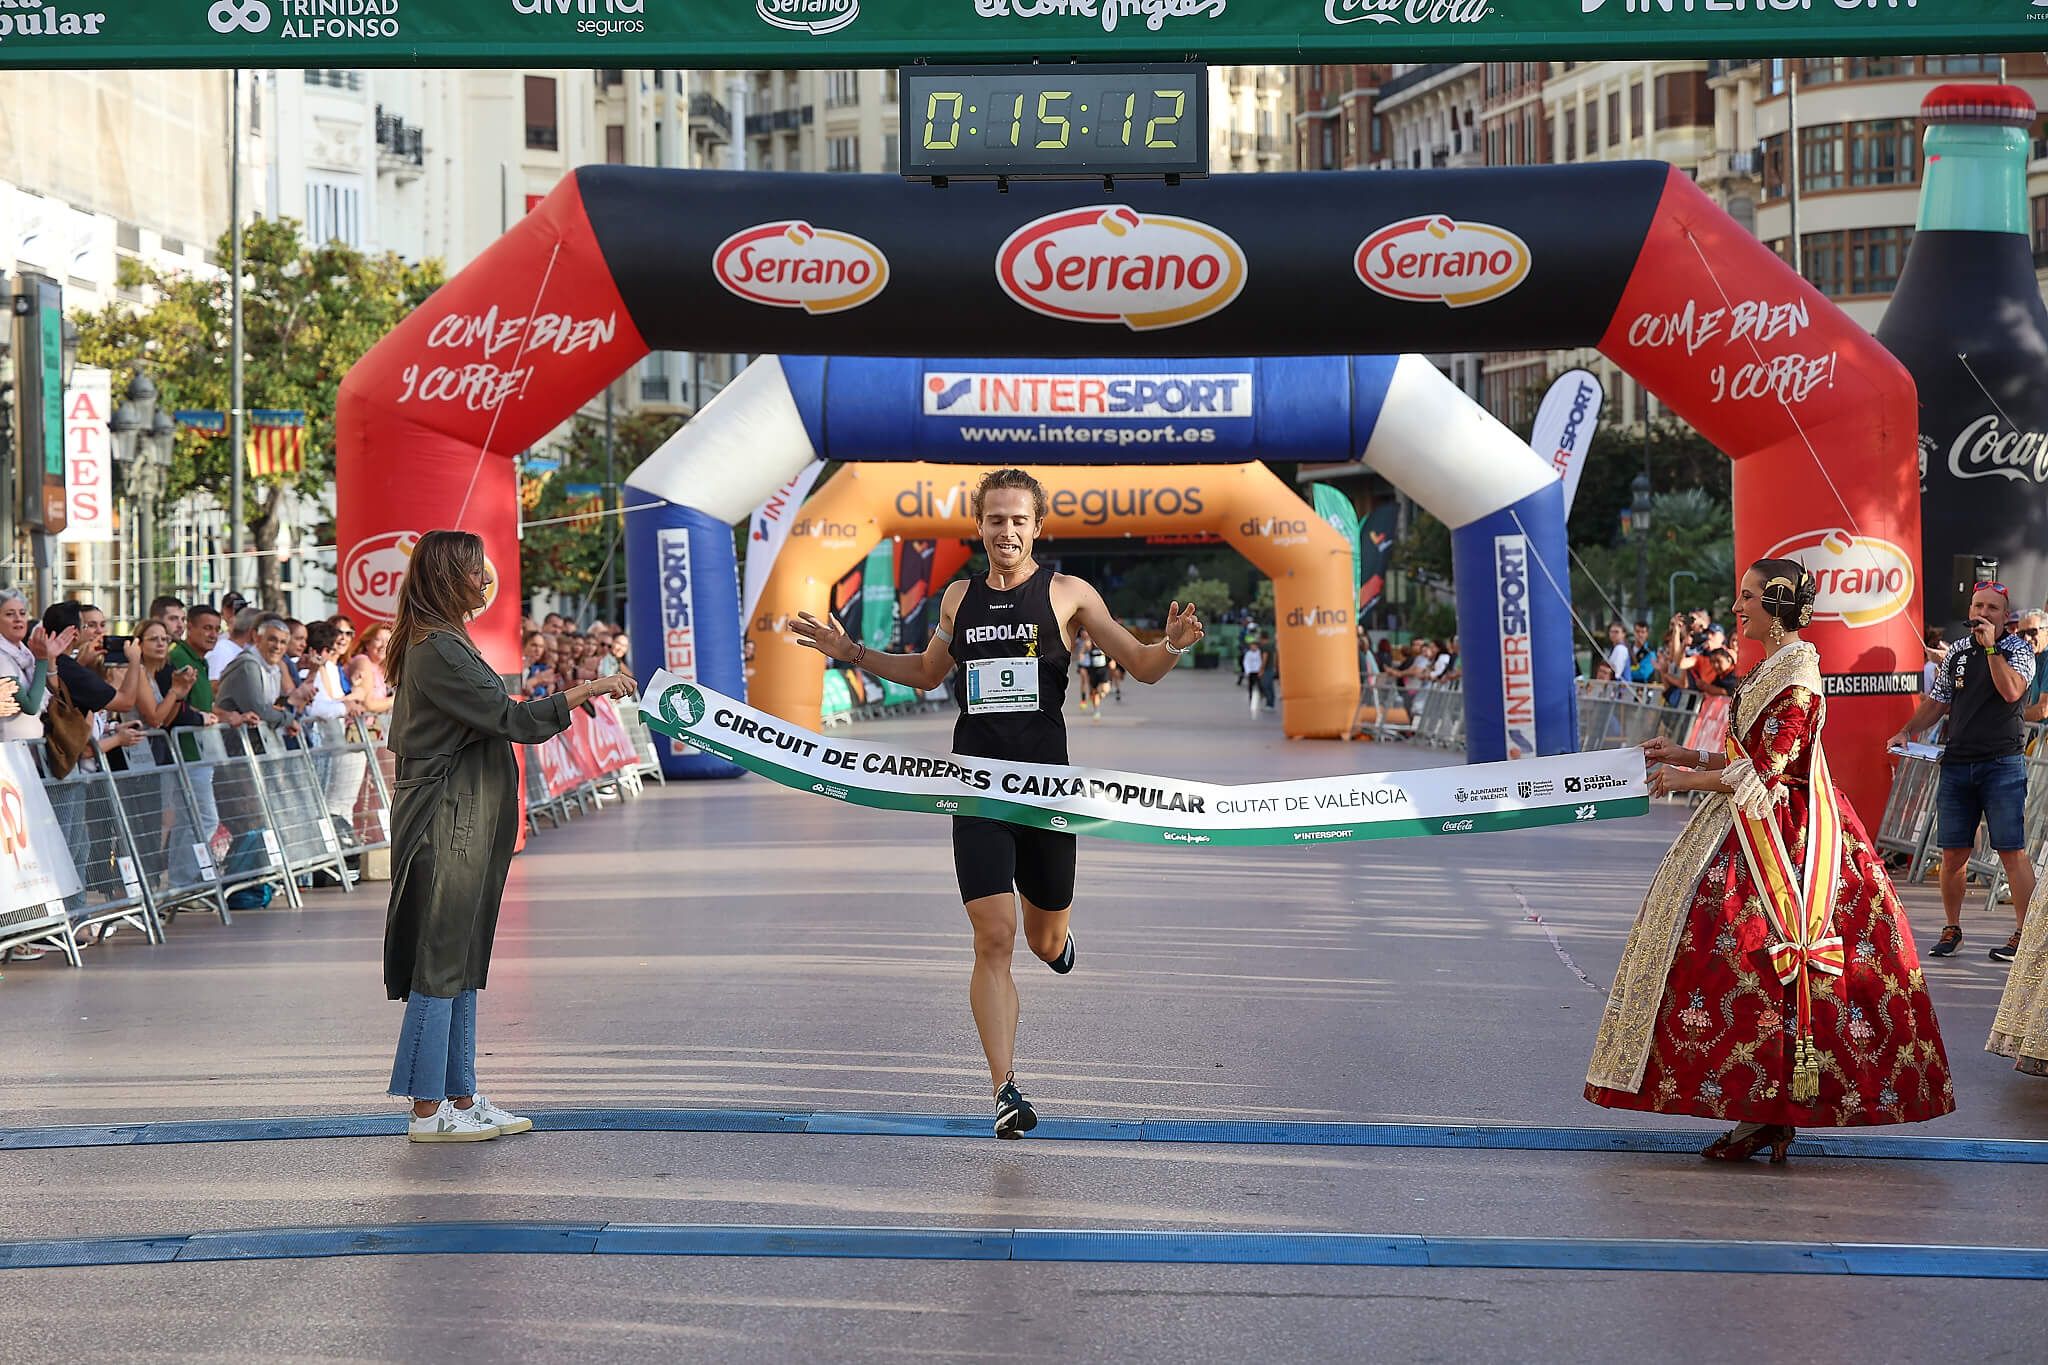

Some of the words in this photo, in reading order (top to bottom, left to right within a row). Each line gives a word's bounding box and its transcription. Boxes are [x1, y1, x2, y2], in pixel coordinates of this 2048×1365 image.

[282, 0, 400, 15] TRINIDAD
[281, 18, 399, 38] ALFONSO
[576, 20, 644, 37] seguros
[922, 89, 1186, 150] 0:15:12
[733, 246, 870, 285] Serrano
[1024, 239, 1221, 292] Serrano
[1374, 242, 1513, 279] Serrano
[427, 304, 527, 359] COME
[521, 310, 616, 355] BIEN
[1628, 300, 1726, 356] COME
[1724, 297, 1810, 347] BIEN
[419, 363, 535, 411] CORRE!
[1731, 351, 1838, 406] CORRE!
[979, 378, 1239, 413] INTERSPORT
[960, 424, 1216, 446] www.intersport.es
[895, 480, 974, 520] divi
[791, 517, 857, 538] divina
[1240, 516, 1307, 538] divina
[354, 559, 403, 597] Ser
[1808, 567, 1904, 595] rrano
[663, 538, 694, 681] ERSPORT
[756, 612, 790, 633] divi
[1286, 606, 1347, 628] divina
[966, 624, 1033, 645] REDOLAT
[1499, 543, 1533, 725] INTERSPORT
[1000, 670, 1015, 688] 9
[714, 708, 818, 758] CIRCUIT
[822, 748, 859, 770] DE
[863, 753, 992, 791] CARRERES
[1216, 798, 1279, 814] CIUTAT
[1285, 796, 1310, 811] DE
[1314, 788, 1408, 809] VALÈNCIA
[1584, 774, 1611, 783] caixa
[1584, 780, 1628, 791] popular
[1302, 830, 1353, 839] INTERSPORT
